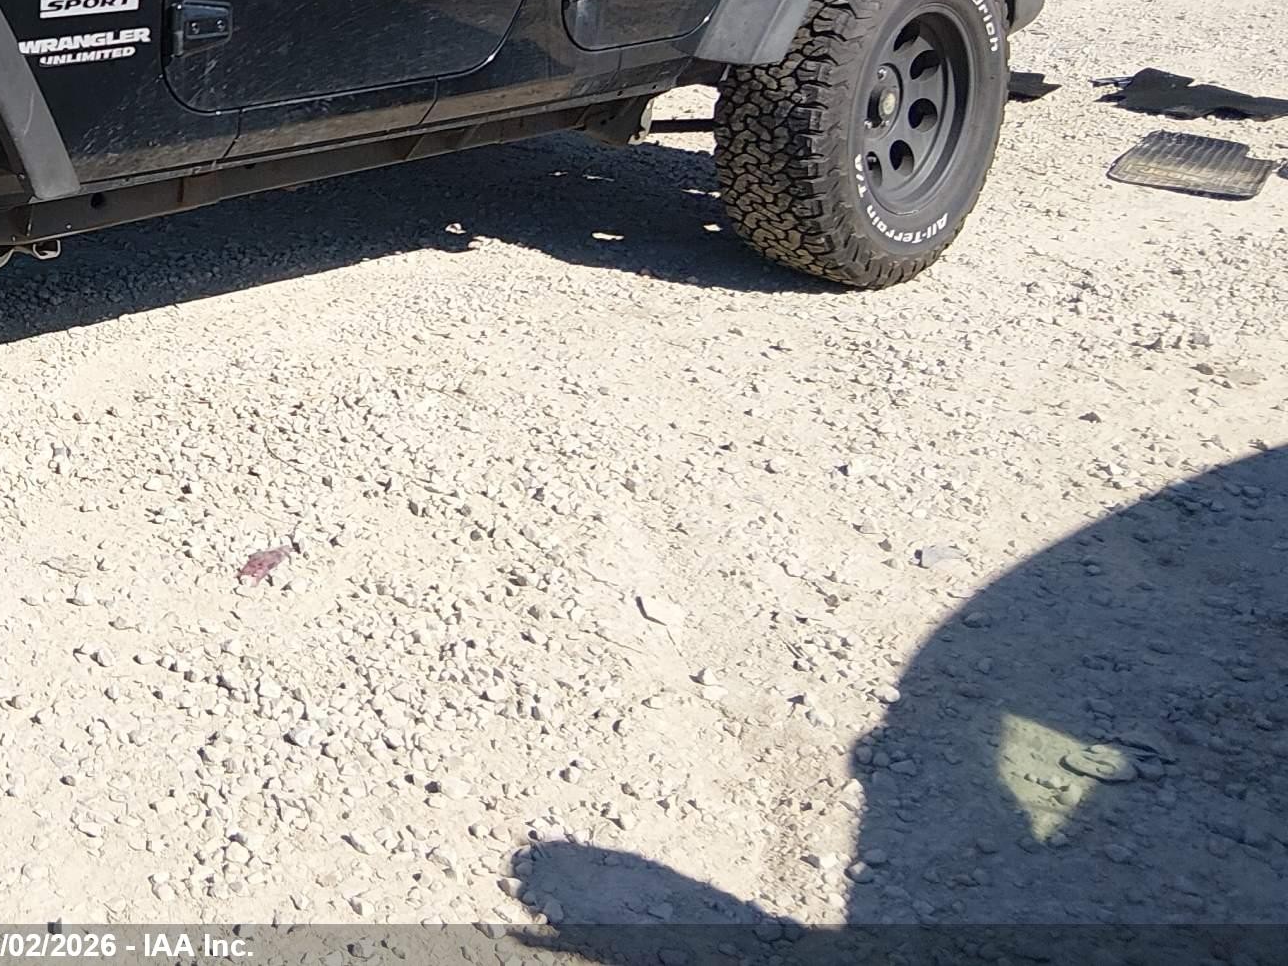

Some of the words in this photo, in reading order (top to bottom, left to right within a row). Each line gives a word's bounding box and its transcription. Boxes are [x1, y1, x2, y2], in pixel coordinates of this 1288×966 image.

[18, 27, 151, 55] WRANGLER
[39, 46, 136, 66] UNLIMITED
[866, 204, 949, 244] All-Terrain
